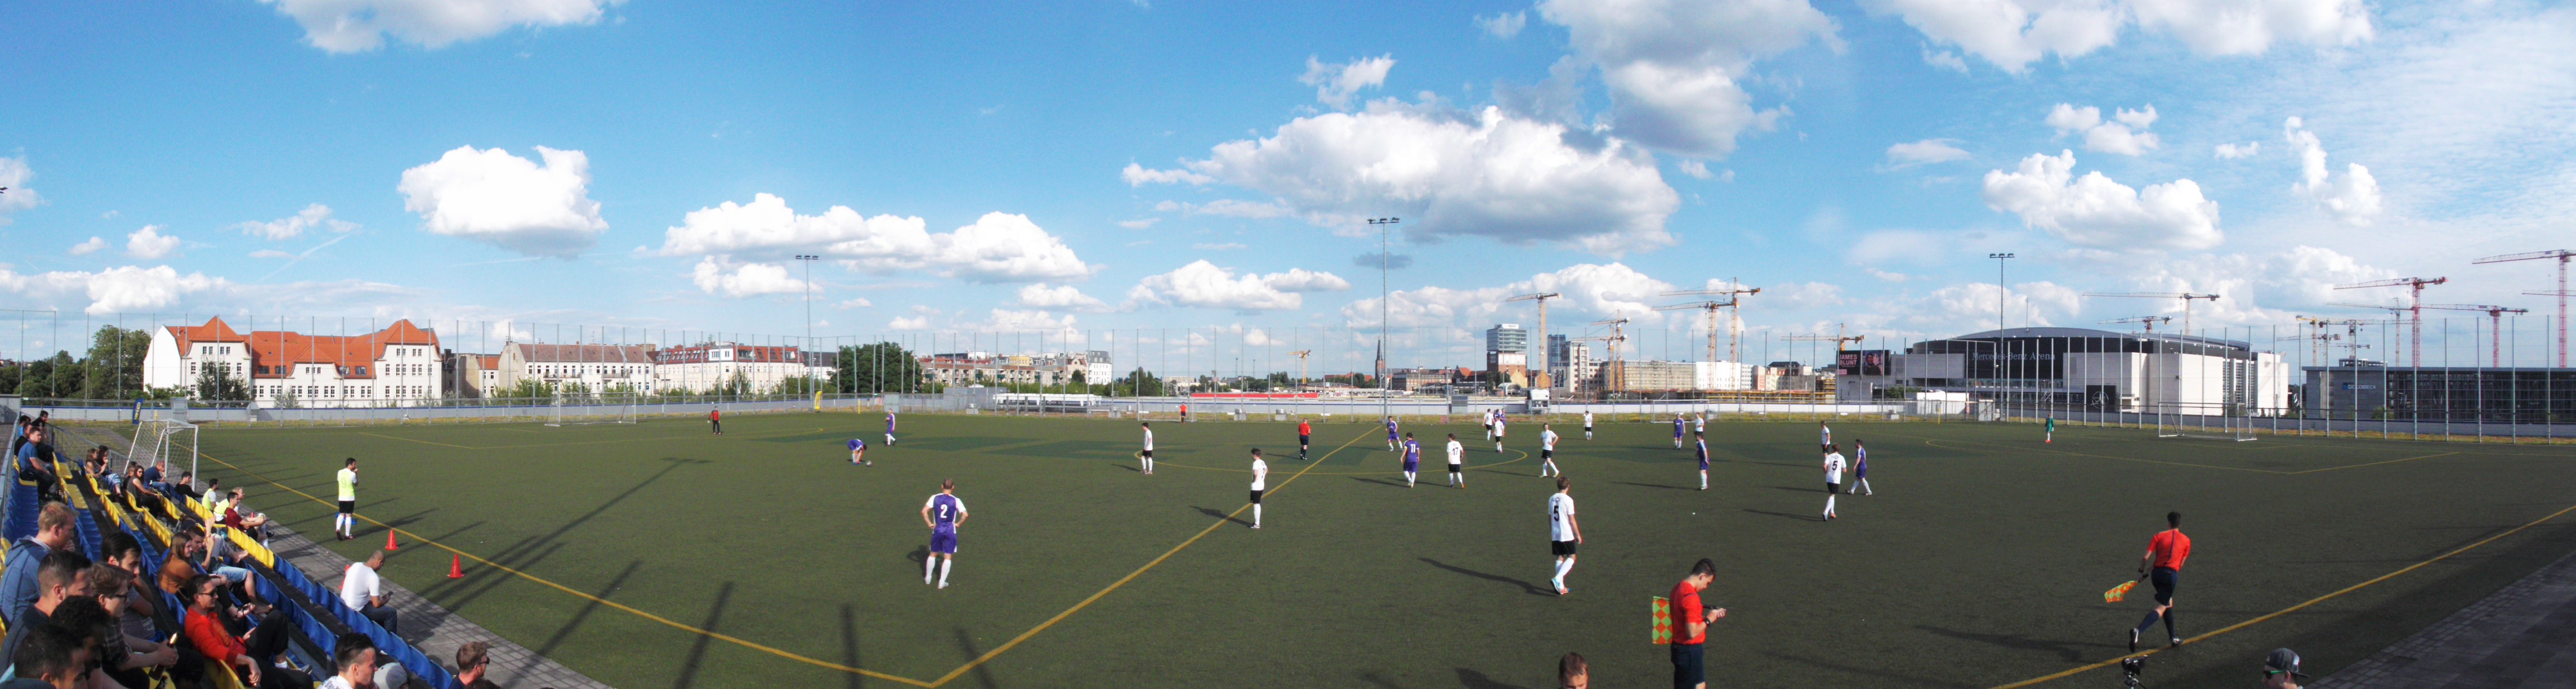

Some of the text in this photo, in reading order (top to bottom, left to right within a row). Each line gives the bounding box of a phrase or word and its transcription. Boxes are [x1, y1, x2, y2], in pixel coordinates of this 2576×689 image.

[1410, 443, 1416, 453] 11
[1452, 447, 1459, 456] 17
[1832, 461, 1838, 470] 5
[940, 504, 948, 518] 2
[1554, 505, 1560, 522] 5
